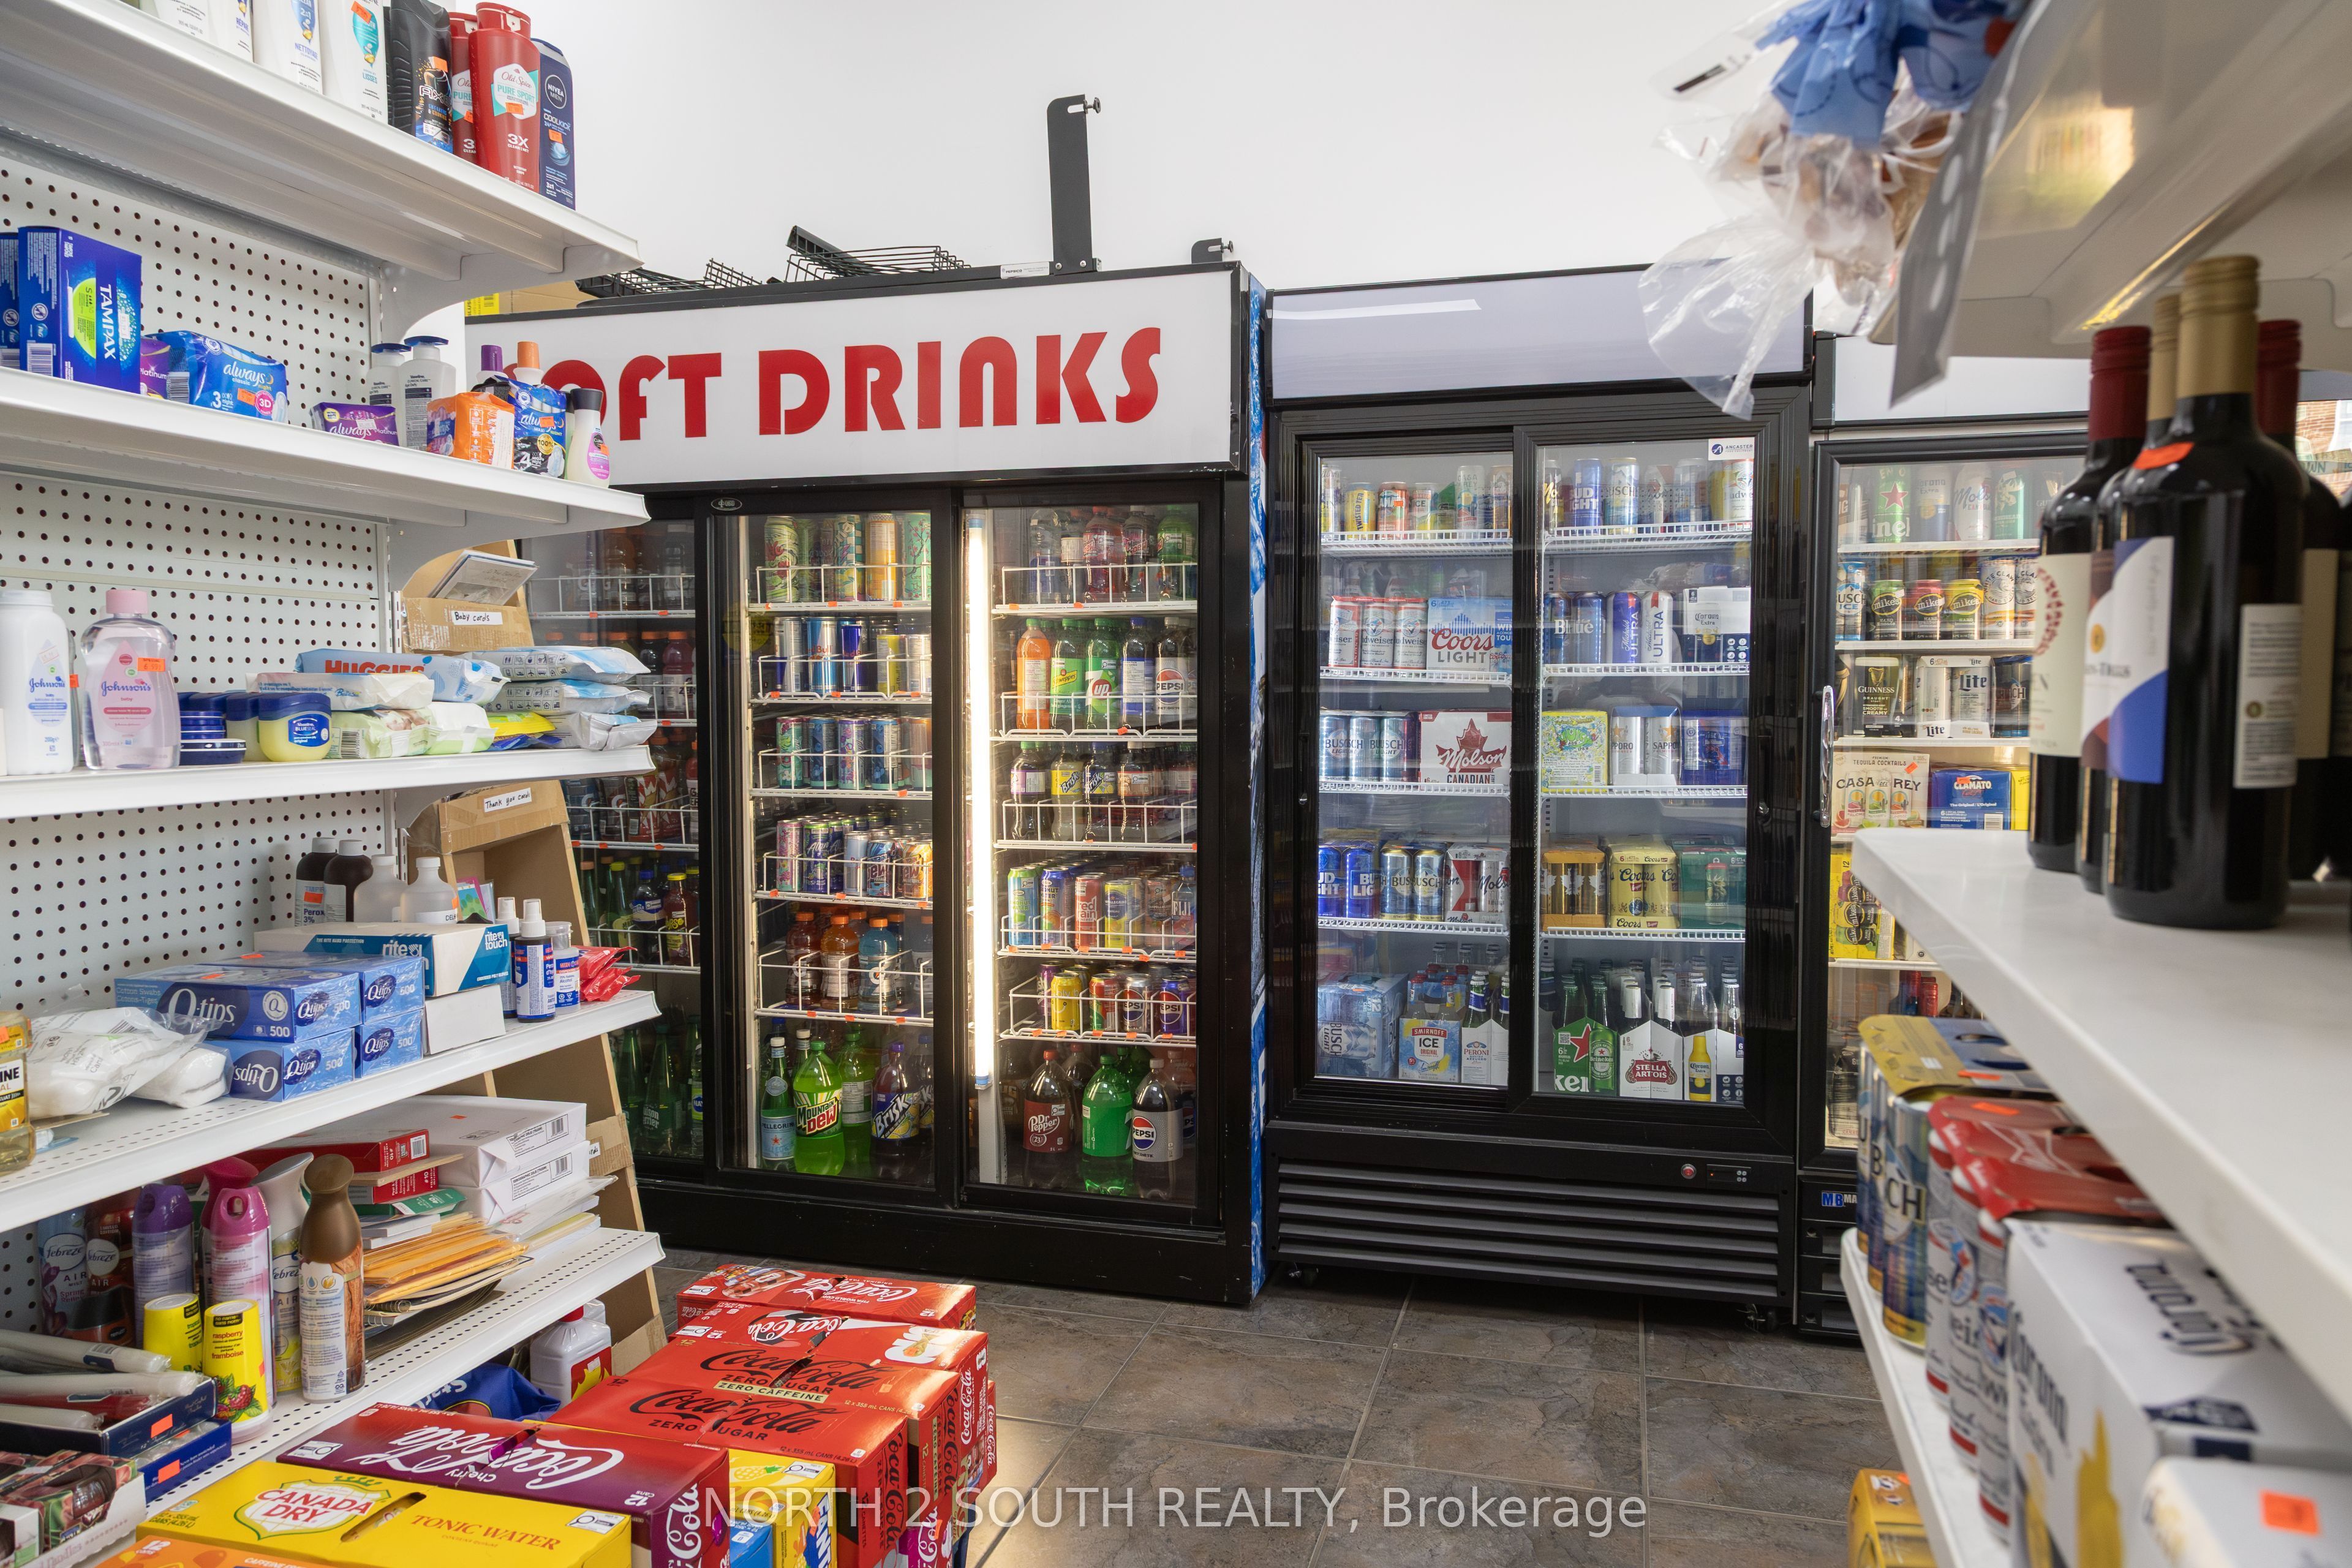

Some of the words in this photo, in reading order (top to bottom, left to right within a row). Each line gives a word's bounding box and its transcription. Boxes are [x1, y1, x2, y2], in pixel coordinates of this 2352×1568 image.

[502, 72, 515, 82] Old
[516, 76, 532, 89] Spice
[497, 83, 516, 94] PURE
[517, 89, 536, 102] SPORT
[548, 85, 564, 97] NIVEA
[550, 91, 562, 102] MEN
[508, 133, 529, 148] 3X
[99, 285, 117, 360] TAMPAX
[223, 361, 266, 387] always
[232, 377, 251, 386] classic
[503, 352, 723, 441] OFT
[758, 326, 1161, 436] DRINKS
[258, 398, 272, 409] 3D
[1873, 598, 1900, 609] mike's
[1952, 598, 1979, 609] mike's
[455, 611, 470, 622] Baby
[473, 613, 490, 622] cards
[1695, 612, 1719, 621] Corona
[1431, 628, 1494, 651] Coors
[1653, 610, 1664, 657] ULTRA
[1438, 651, 1487, 663] LIGHT
[29, 676, 66, 692] Johnson's
[101, 678, 151, 694] Johnson's
[1156, 682, 1183, 691] PEPSI
[1959, 674, 1987, 690] Lite
[1858, 685, 1894, 694] GUINNESS
[1926, 725, 1945, 737] Lite
[1441, 748, 1504, 769] Molson
[1060, 771, 1080, 794] Brisk
[1447, 774, 1490, 785] CANADIAN
[1836, 777, 1875, 789] CASA
[1893, 777, 1921, 791] REY
[1953, 781, 1992, 790] CLAMATO
[485, 799, 503, 809] Thank
[506, 796, 516, 806] you
[1172, 900, 1191, 917] FIJI
[1616, 918, 1642, 929] Coors
[486, 931, 497, 941] rite
[382, 940, 409, 956] rite
[486, 938, 507, 951] touch
[117, 987, 138, 995] Cotton
[139, 988, 162, 997] Swabs
[168, 988, 236, 1027] Q-tips
[270, 1025, 291, 1039] 500
[1414, 1028, 1446, 1037] SMIRNOFF
[398, 1037, 413, 1049] 500
[1419, 1038, 1439, 1049] ICE
[325, 1058, 344, 1071] 500
[234, 1062, 278, 1093] Q-tips
[1635, 1071, 1667, 1079] ARTOIS
[874, 1094, 910, 1136] Brisk
[1029, 1115, 1058, 1133] Pepper
[1133, 1129, 1155, 1138] PEPSI
[43, 1243, 83, 1259] febreze
[64, 1271, 88, 1283] AIR
[213, 1330, 243, 1340] raspberry
[211, 1350, 244, 1359] framboise
[722, 1374, 769, 1386] ZERO
[775, 1381, 834, 1395] UGAR
[718, 1382, 756, 1393] ZERO
[758, 1387, 824, 1403] CAFFEINE
[960, 1367, 973, 1445] Coca-Cola
[649, 1419, 698, 1432] ZERO
[710, 1426, 769, 1442] UGAR
[986, 1404, 996, 1466] Coca-Cola
[445, 1468, 497, 1483] Cherry
[257, 1489, 372, 1514] CANADA
[624, 1494, 649, 1507] 12
[262, 1504, 326, 1523] DRY
[411, 1515, 482, 1535] TONIC
[482, 1526, 561, 1551] WATER
[143, 1540, 172, 1550] 12
